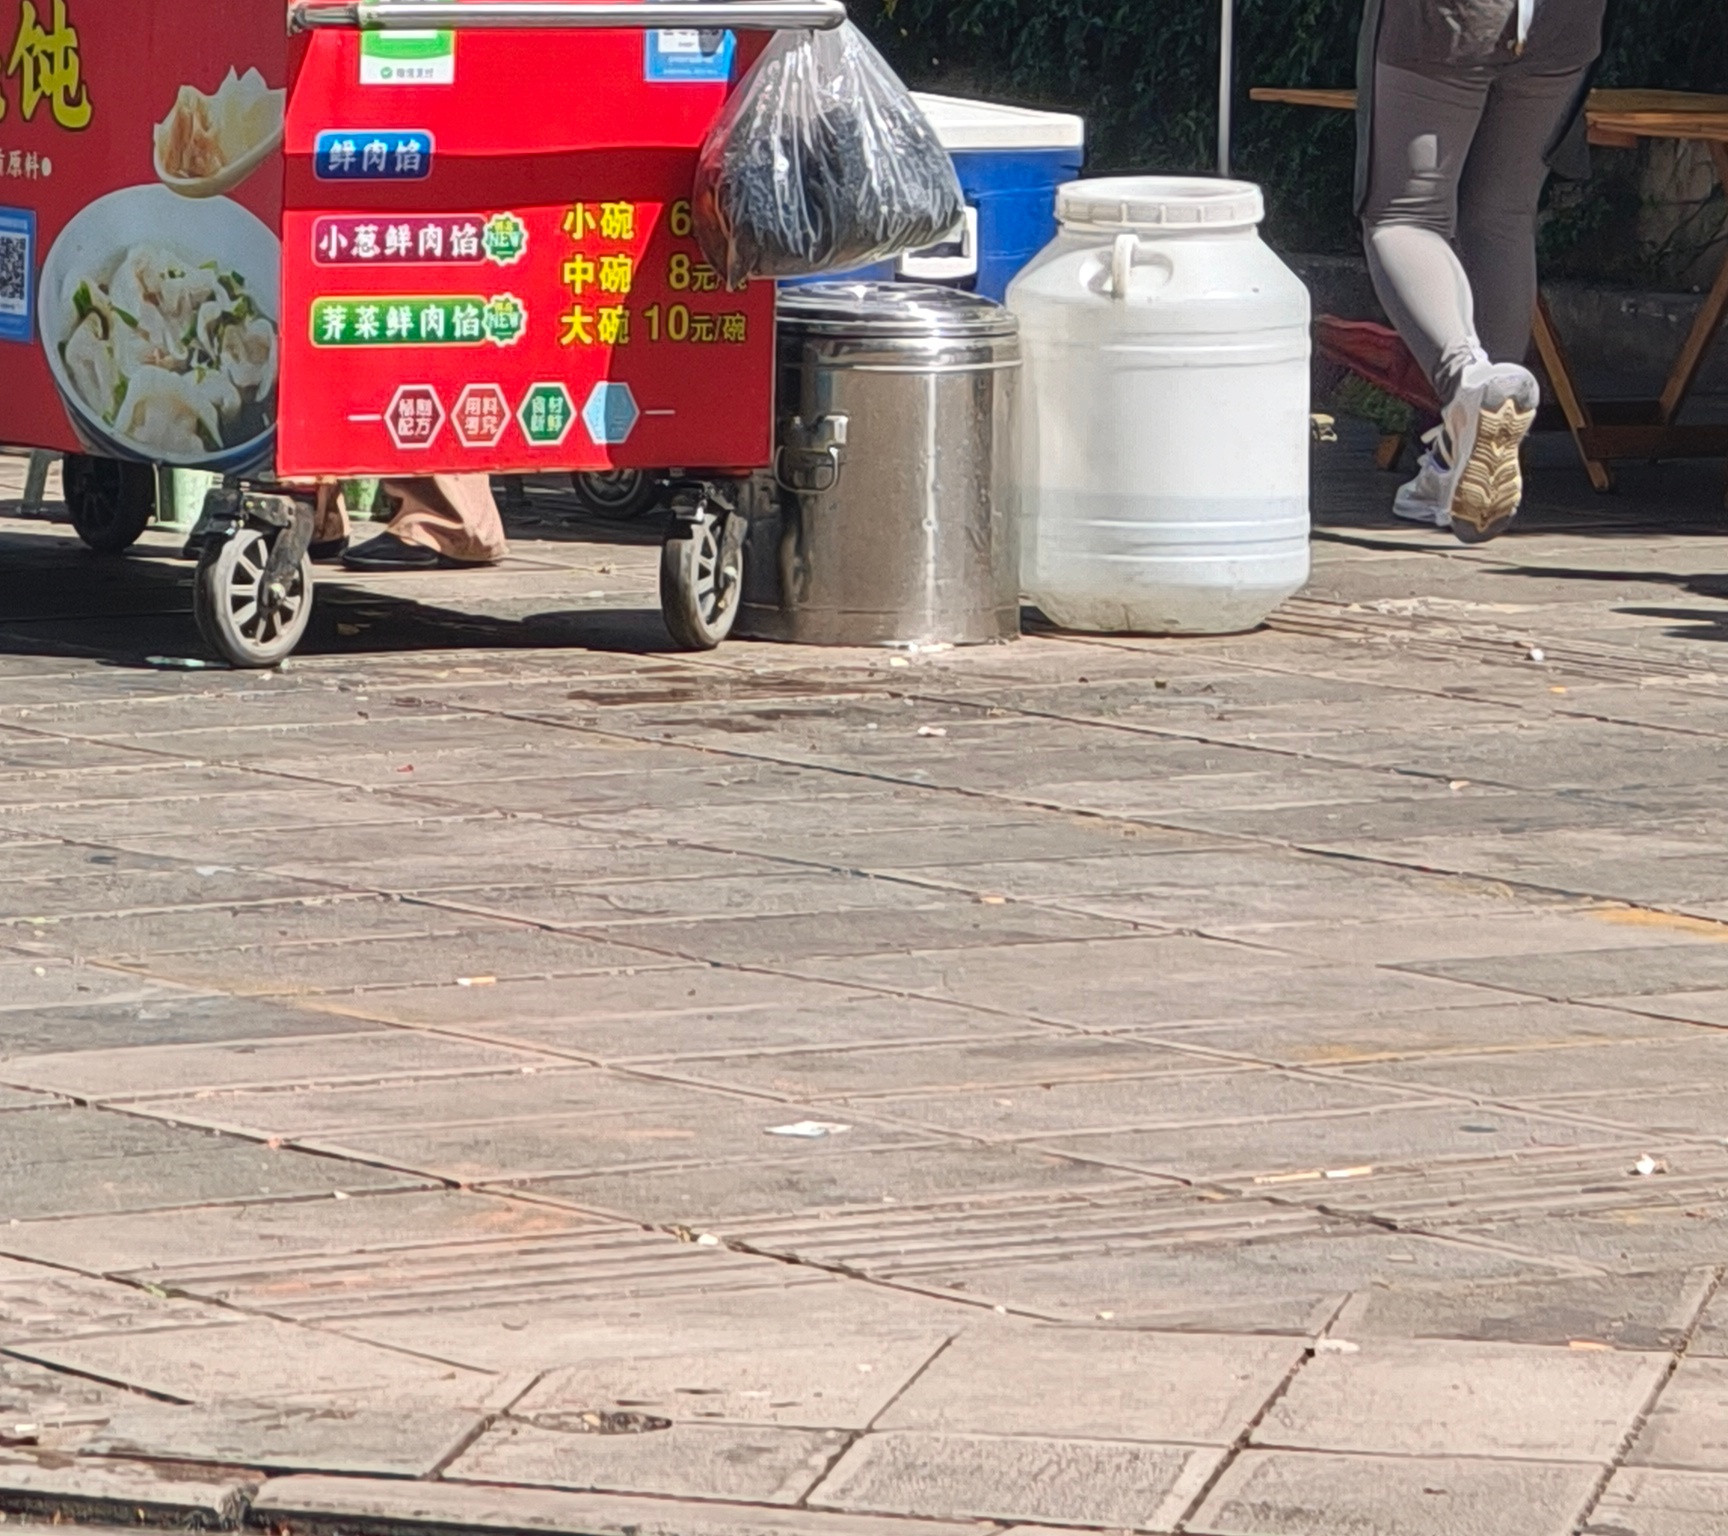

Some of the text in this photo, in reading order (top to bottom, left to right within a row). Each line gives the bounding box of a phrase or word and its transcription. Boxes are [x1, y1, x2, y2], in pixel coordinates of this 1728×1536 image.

[328, 139, 422, 171] 鲜肉馅
[563, 201, 634, 240] 小碗
[319, 222, 480, 259] 小葱鲜肉馅
[563, 253, 748, 294] 中碗 8元/
[322, 302, 481, 341] 荠菜鲜肉馅
[560, 304, 747, 345] 大碗 10元/碗
